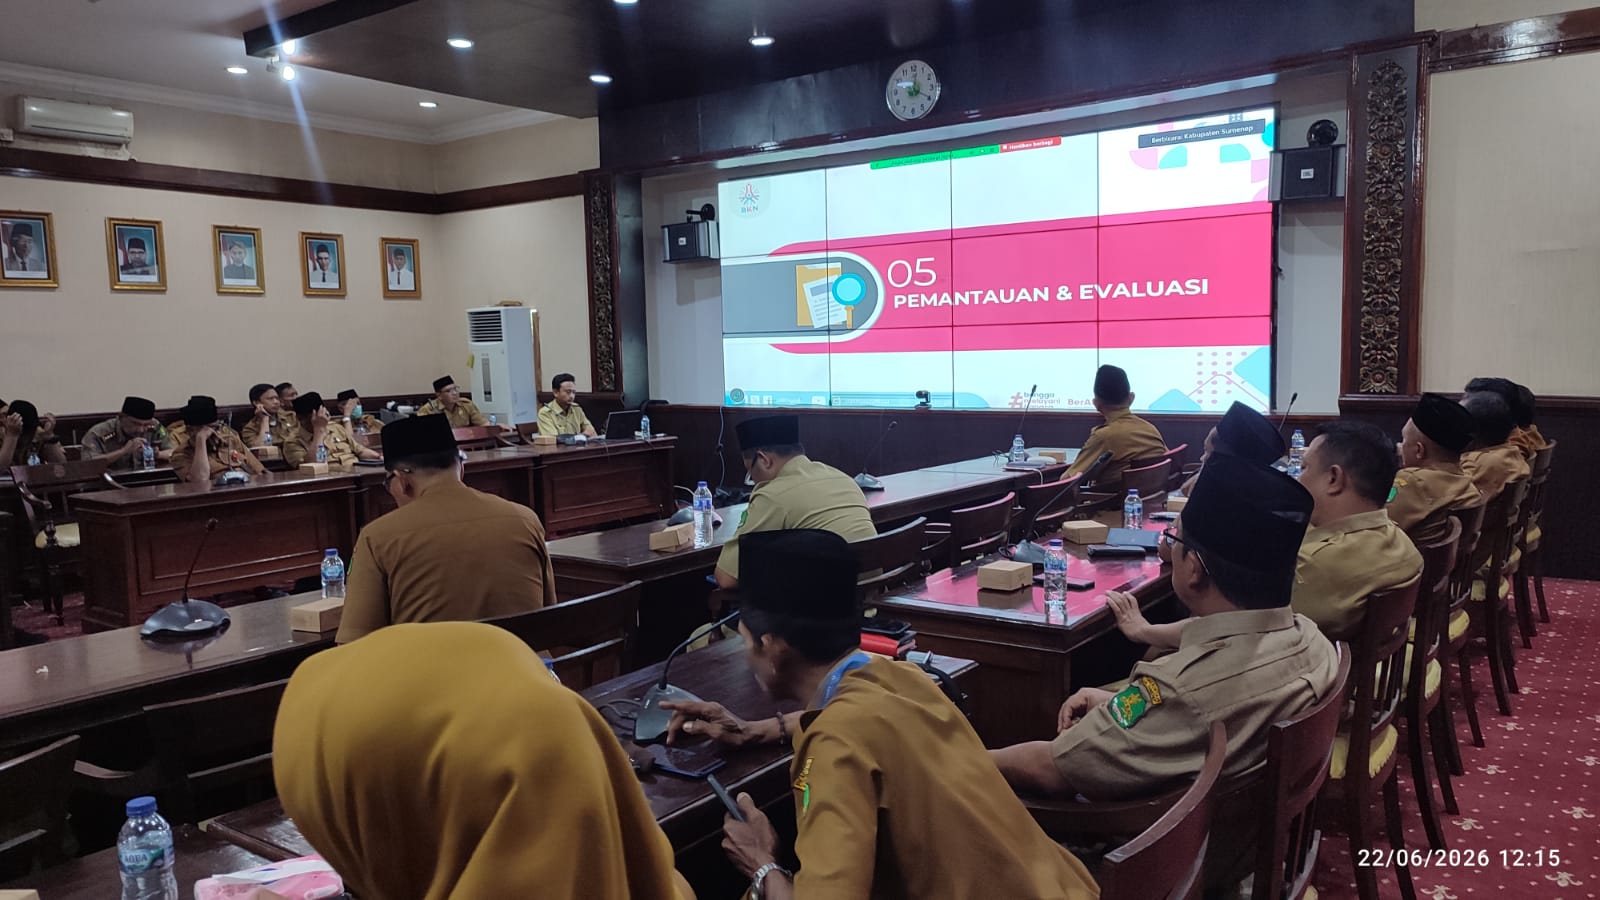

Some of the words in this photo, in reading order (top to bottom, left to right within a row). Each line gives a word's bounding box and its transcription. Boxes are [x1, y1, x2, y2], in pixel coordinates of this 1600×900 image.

[902, 69, 908, 77] 11
[1184, 130, 1220, 139] Kabupaten
[1221, 126, 1253, 135] Sumenep
[887, 257, 937, 288] 05
[893, 285, 1050, 309] PEMANTAUAN
[1056, 285, 1073, 301] &
[1079, 278, 1209, 300] EVALUASI
